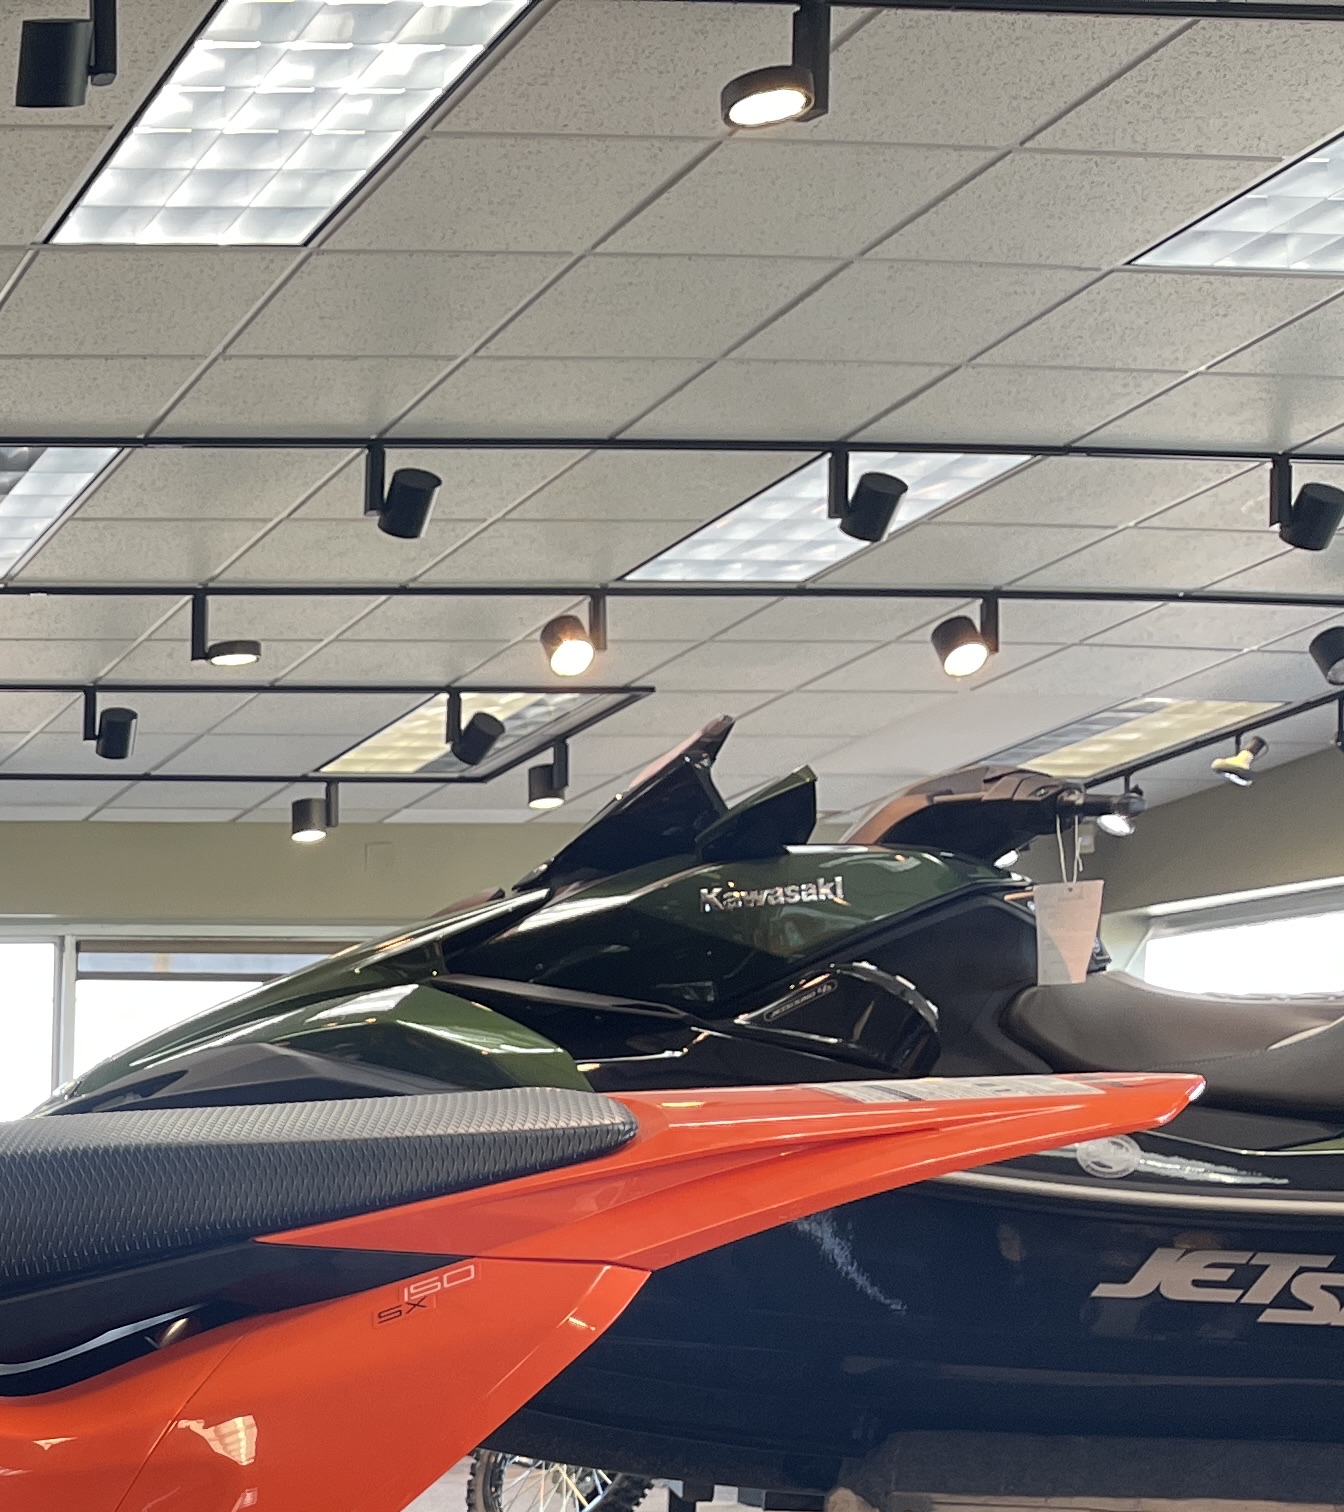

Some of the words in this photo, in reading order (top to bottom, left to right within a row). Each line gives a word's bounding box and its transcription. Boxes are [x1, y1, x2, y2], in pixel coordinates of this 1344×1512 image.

[699, 875, 845, 913] Kawasaki
[404, 1264, 475, 1302] 150
[377, 1295, 428, 1324] SX
